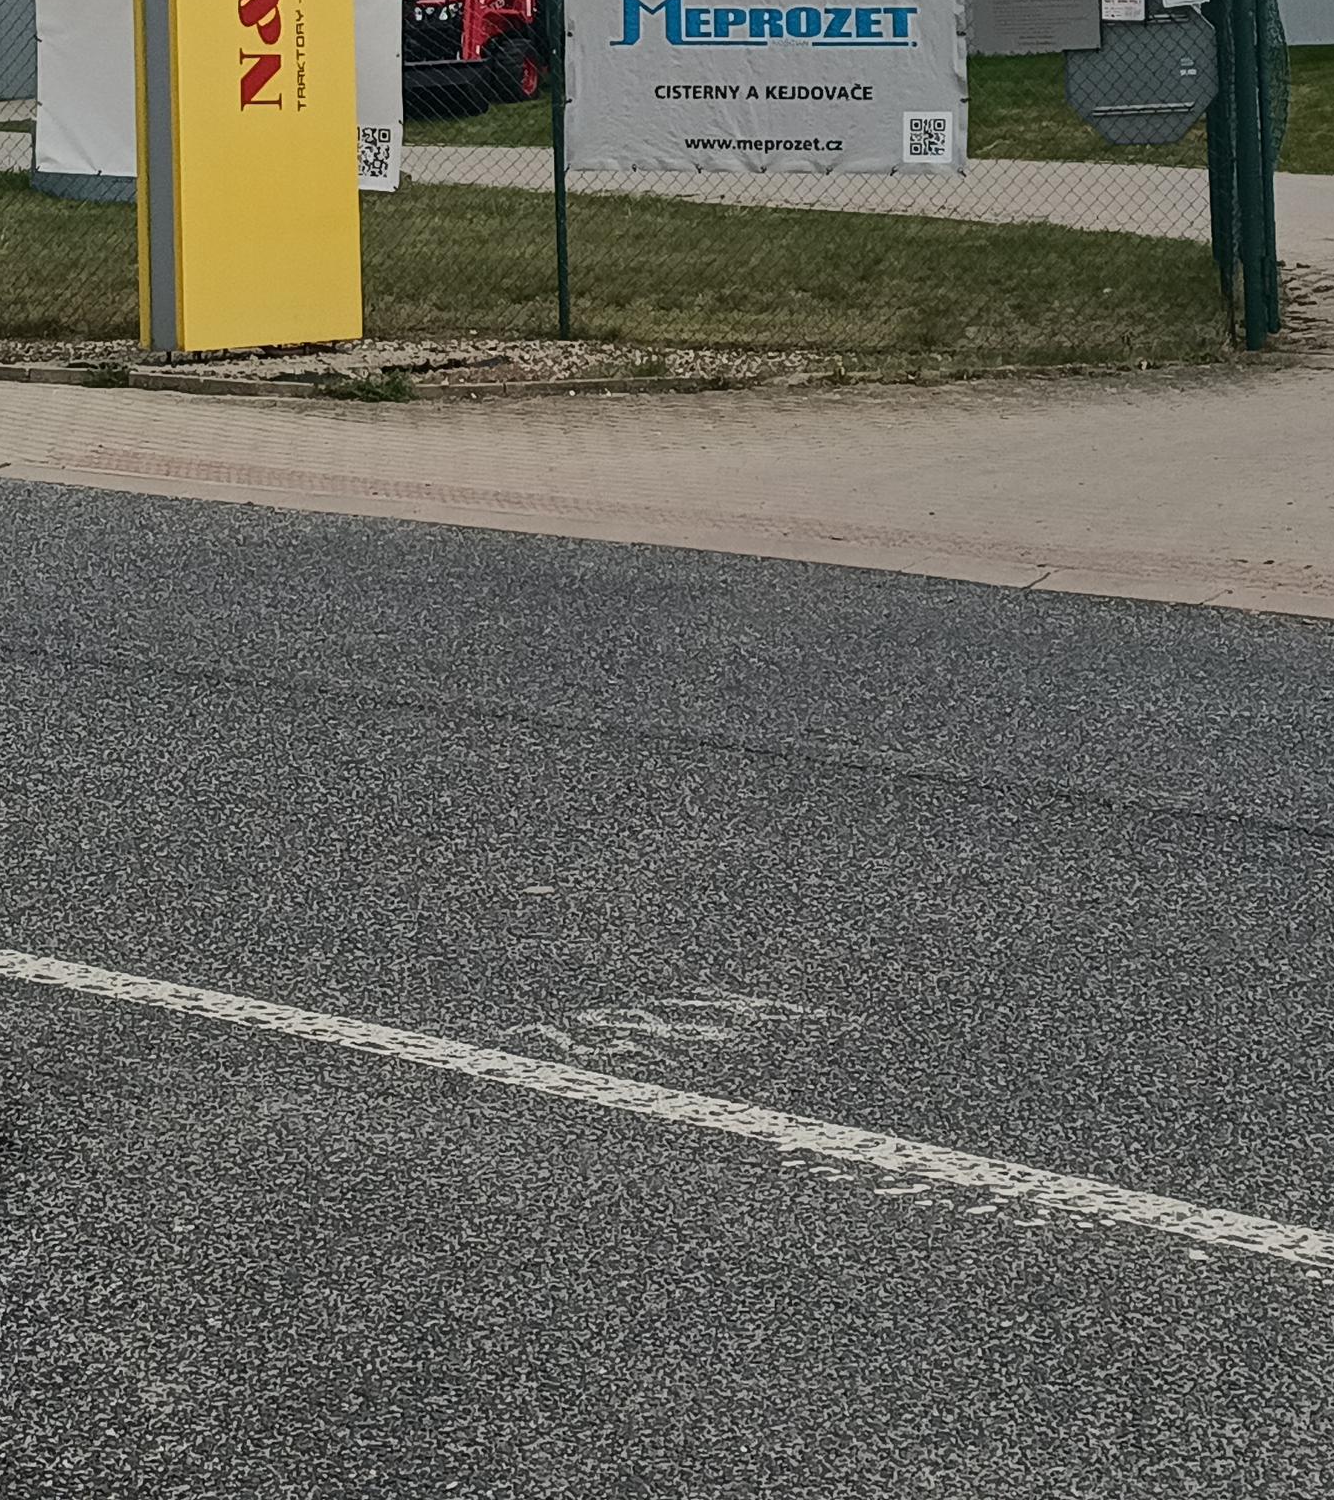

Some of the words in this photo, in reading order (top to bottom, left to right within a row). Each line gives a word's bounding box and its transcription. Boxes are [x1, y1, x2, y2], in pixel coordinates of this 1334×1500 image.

[295, 9, 307, 113] TRAKTORY
[654, 84, 740, 100] CISTERNY
[746, 86, 759, 100] A
[766, 82, 873, 101] KEJDOVAČE
[685, 137, 843, 153] www.meprozet.cz
